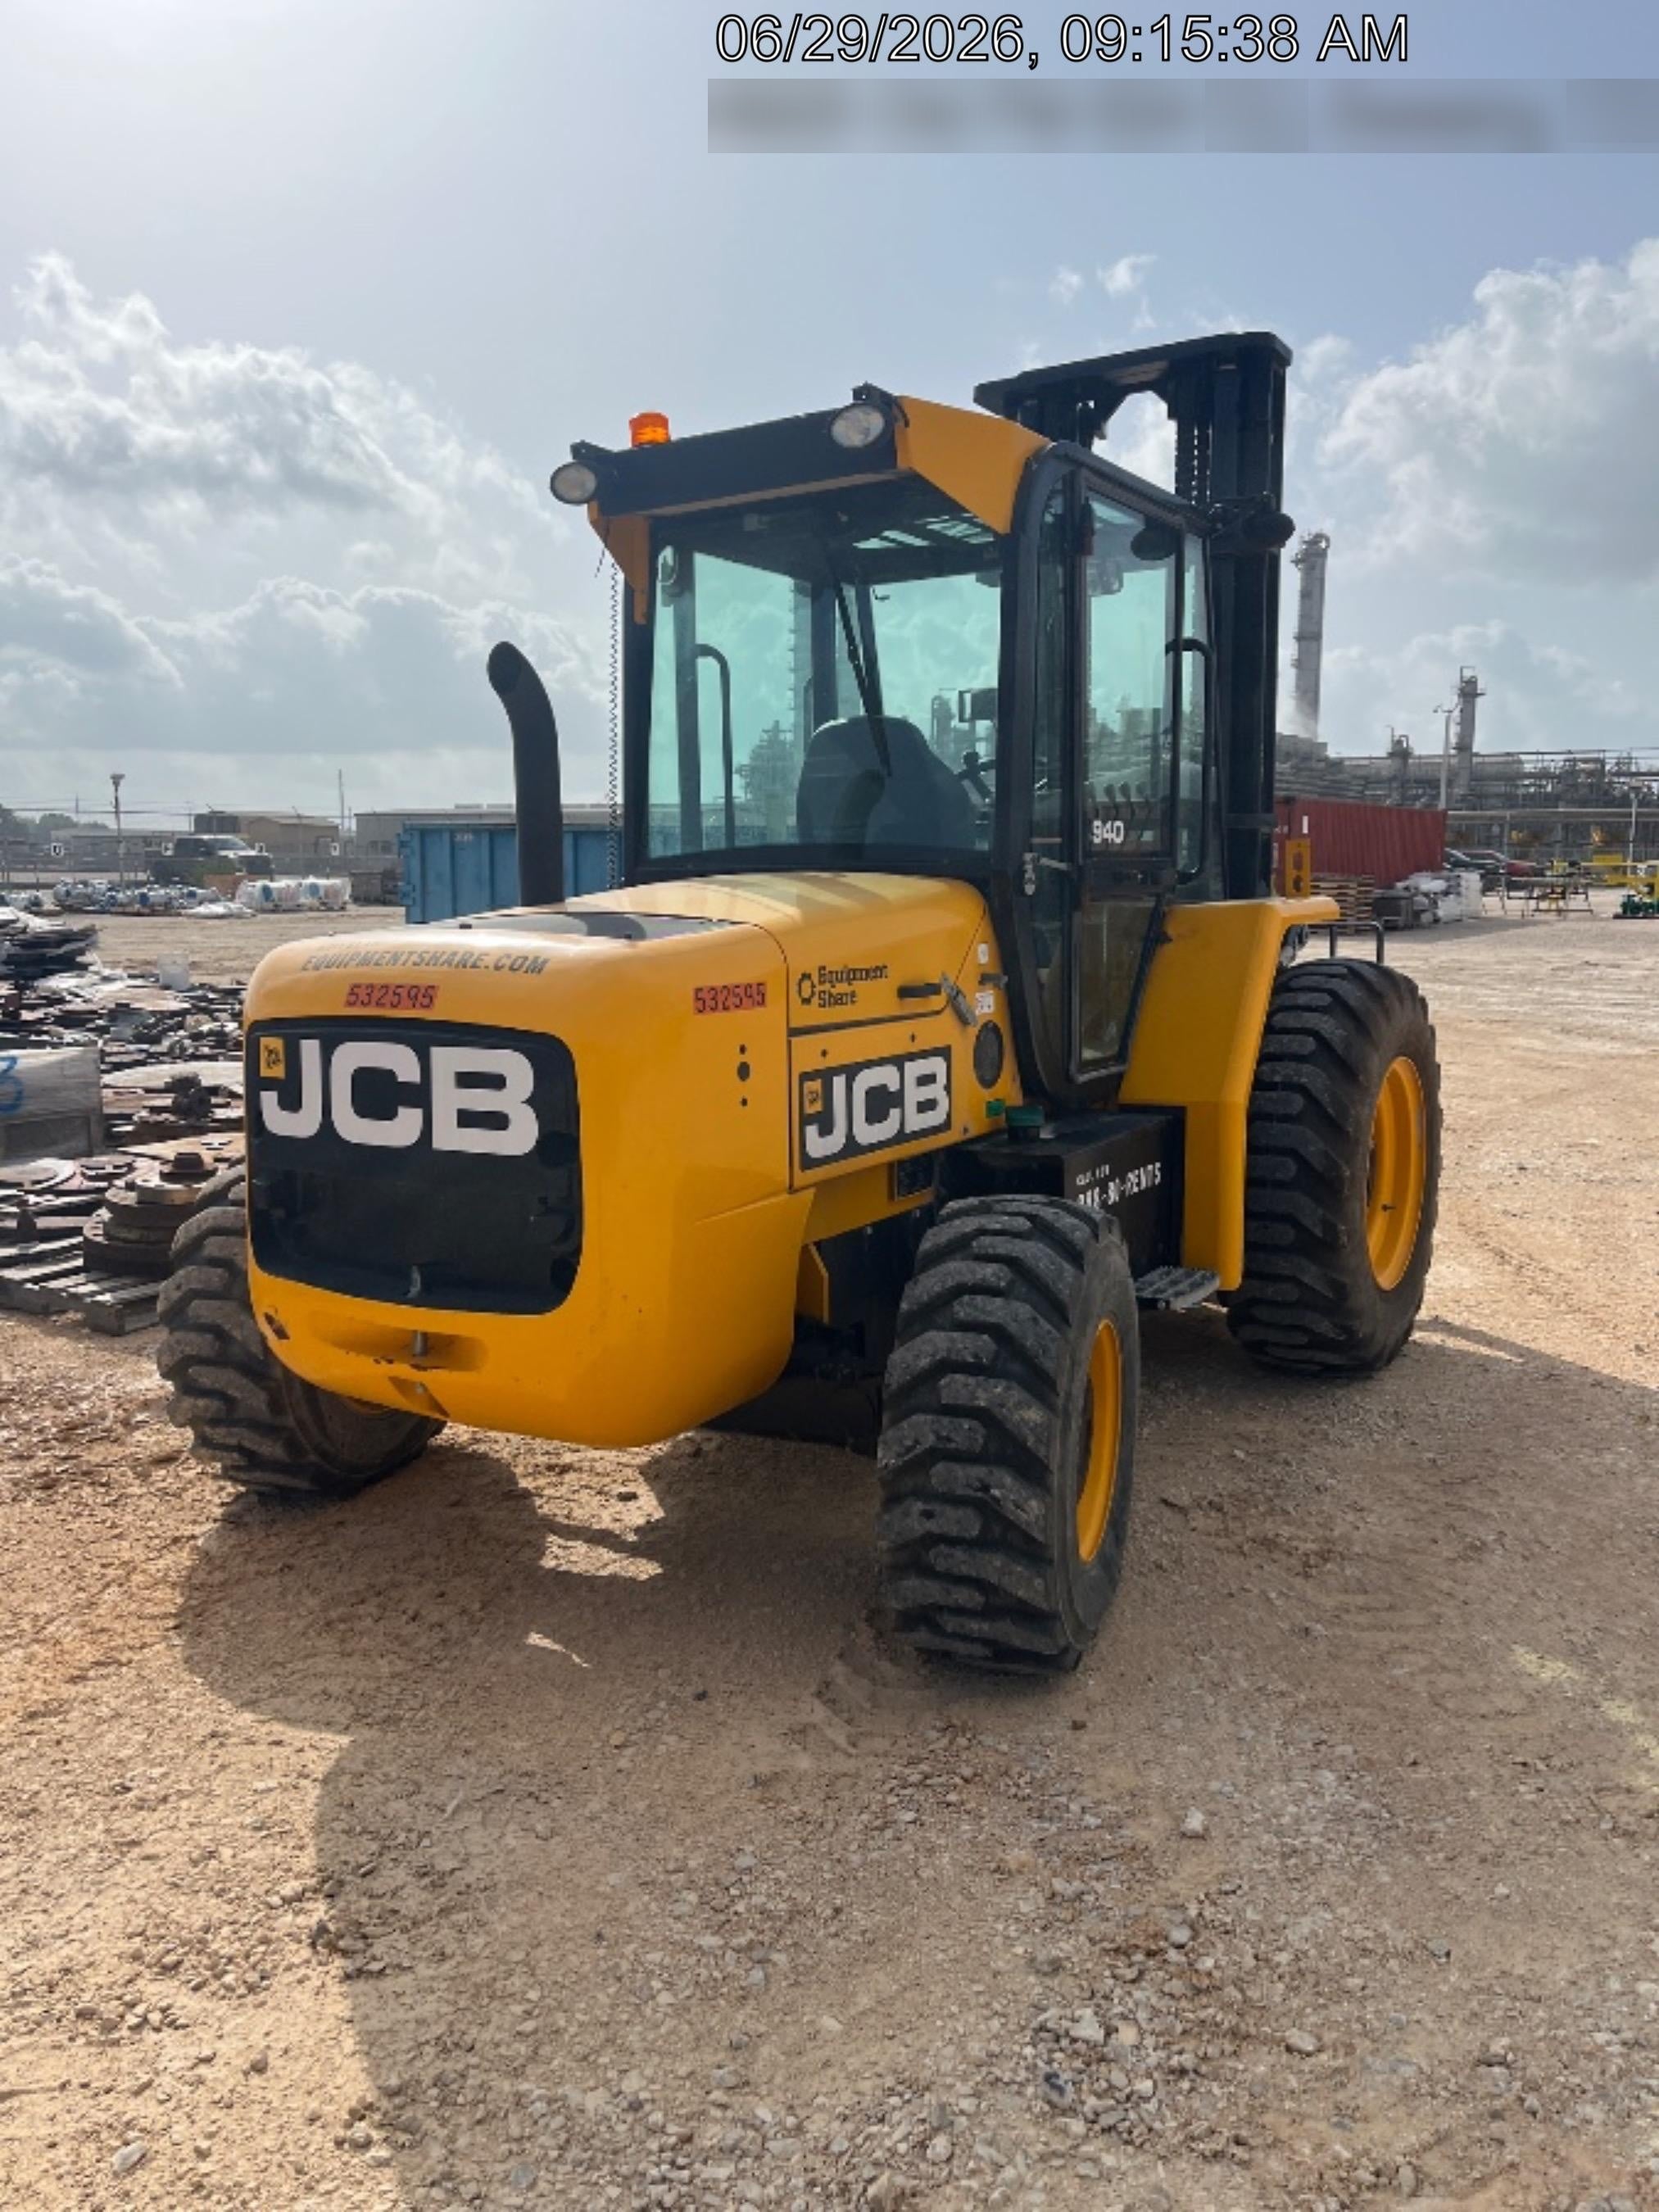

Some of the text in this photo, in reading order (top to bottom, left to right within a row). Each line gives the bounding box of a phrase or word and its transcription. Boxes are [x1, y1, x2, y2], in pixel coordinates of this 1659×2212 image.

[1092, 819, 1125, 845] 940
[301, 950, 550, 975] EQUIPMENTSHARE.COM
[818, 963, 888, 988] Equipment
[345, 983, 436, 1009] 532595
[818, 990, 857, 1008] Share
[259, 1038, 539, 1157] JCB
[805, 1055, 950, 1159] JCB
